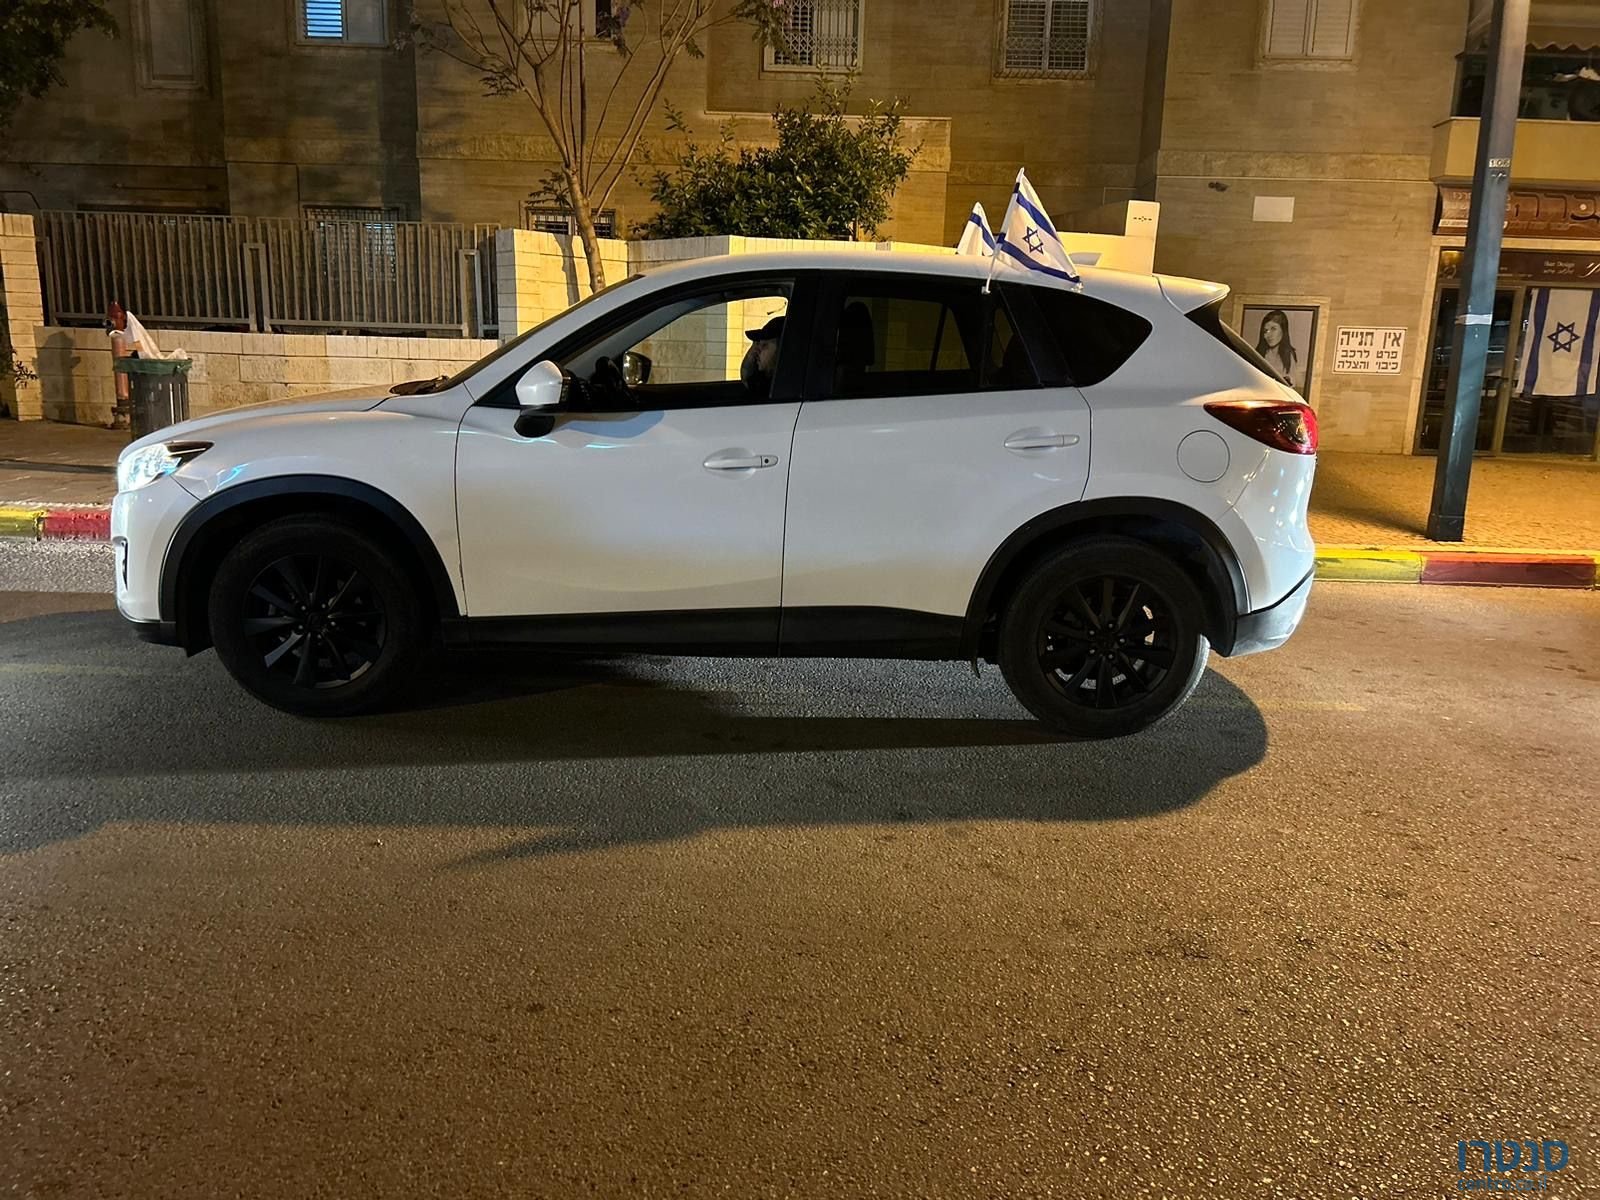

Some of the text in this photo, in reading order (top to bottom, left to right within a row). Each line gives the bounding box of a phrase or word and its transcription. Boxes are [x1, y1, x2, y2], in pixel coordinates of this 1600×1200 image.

[1340, 331, 1402, 349] אין חנייה
[1341, 349, 1398, 359] פרט לרכב
[1337, 360, 1399, 370] כיבוי והצלה
